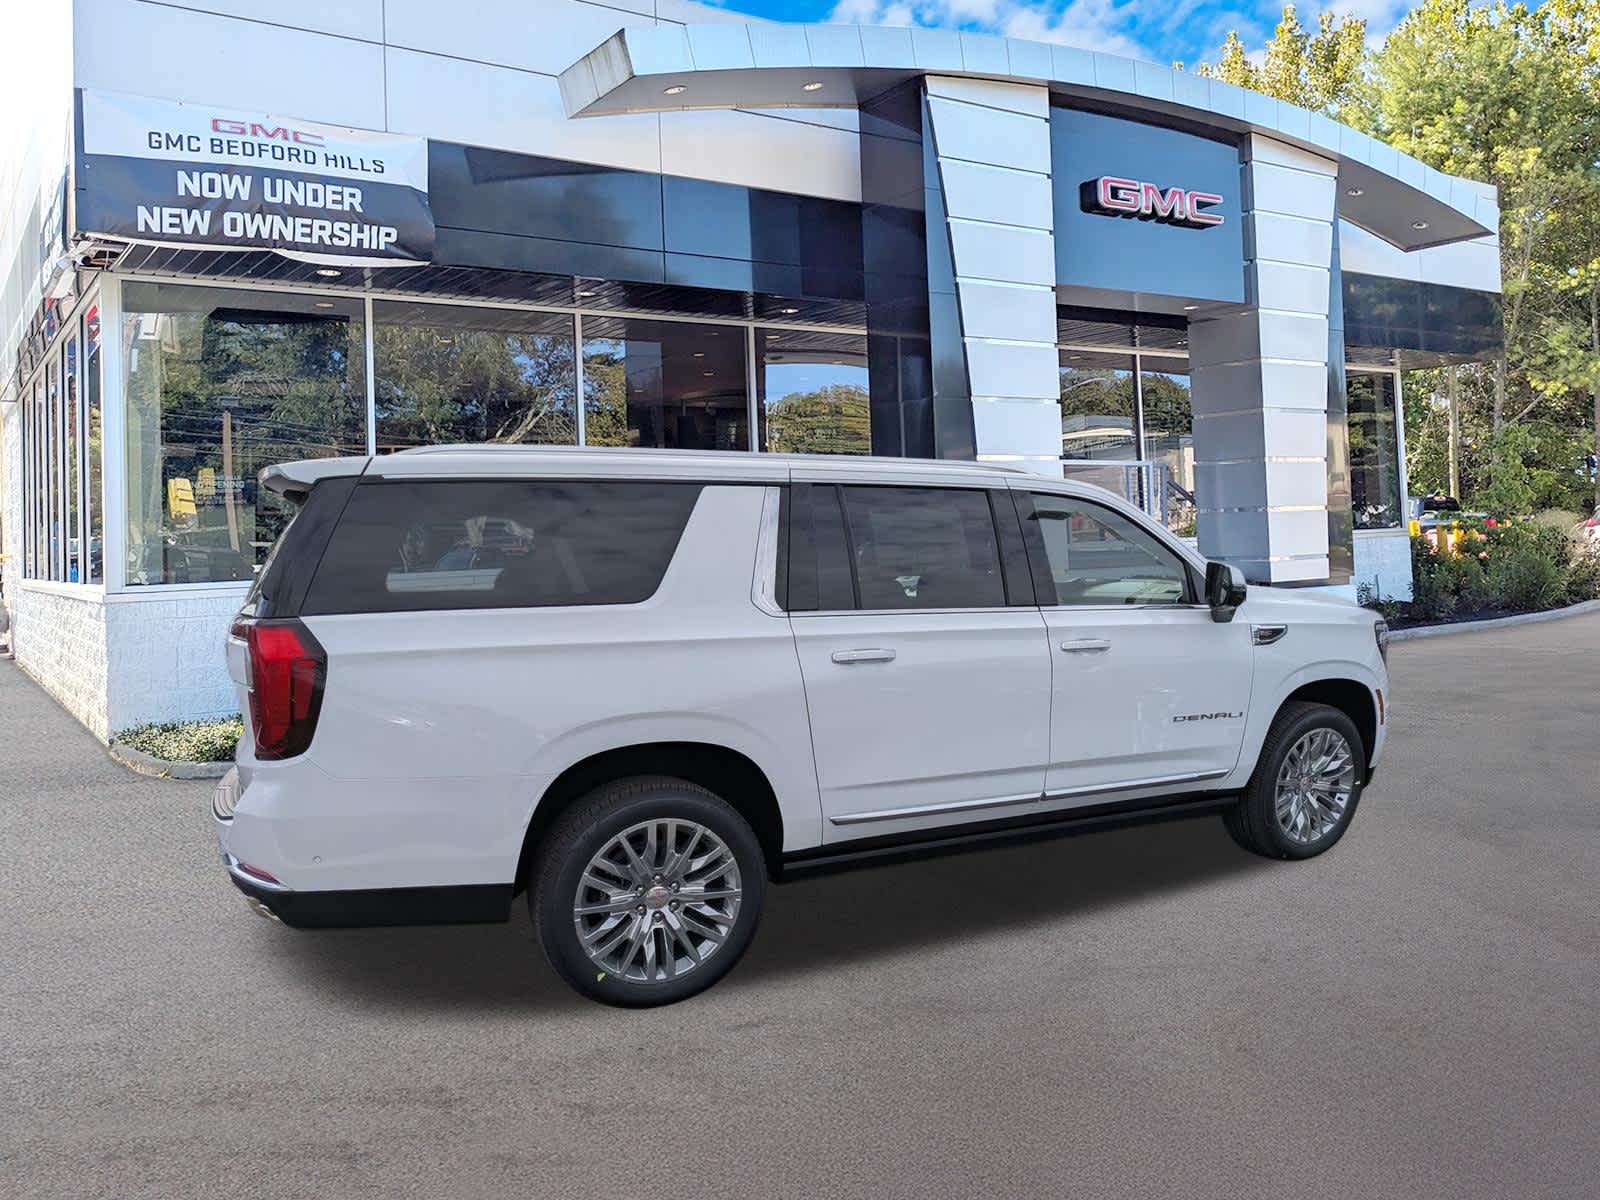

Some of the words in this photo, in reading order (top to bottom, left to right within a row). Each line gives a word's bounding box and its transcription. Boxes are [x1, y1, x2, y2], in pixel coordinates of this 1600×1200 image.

[147, 131, 201, 153] GMC
[209, 137, 317, 165] BEDFORD
[323, 152, 385, 174] HILLS
[210, 118, 326, 148] GMC
[176, 169, 252, 201] NOW
[263, 176, 363, 213] UNDER
[1097, 175, 1225, 225] GMC
[136, 205, 211, 236] NEW
[223, 210, 398, 250] OWNERSHIP
[1172, 711, 1243, 722] DENALI
